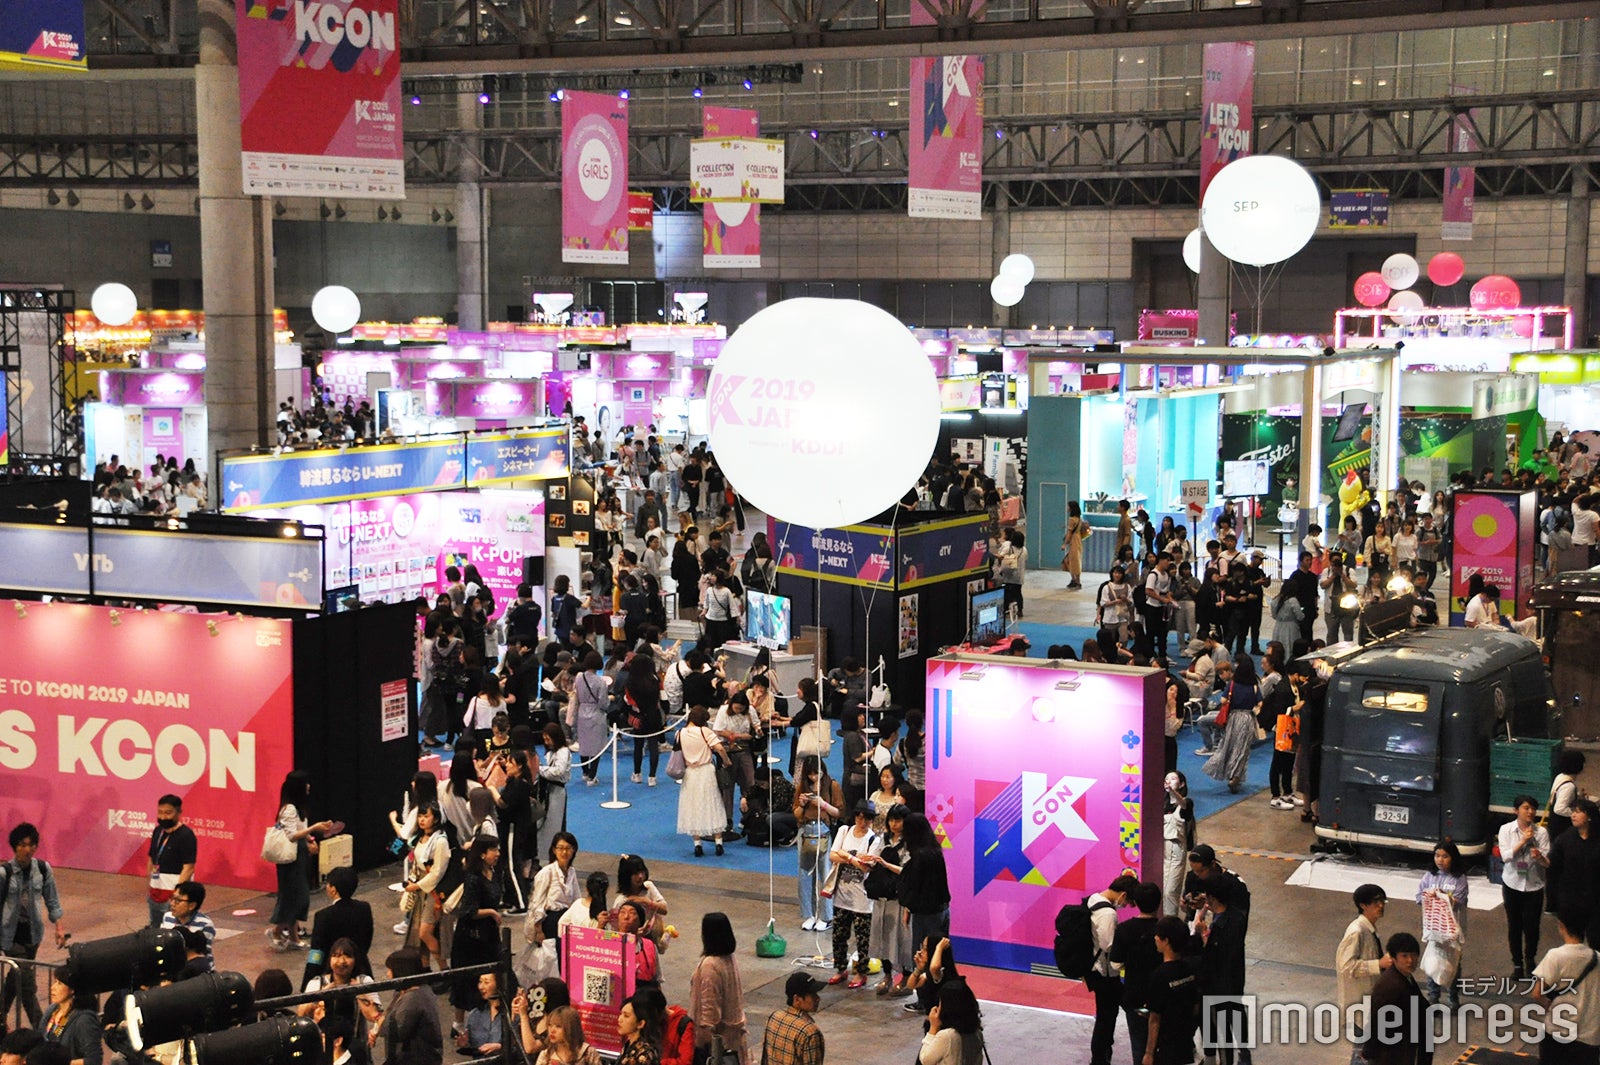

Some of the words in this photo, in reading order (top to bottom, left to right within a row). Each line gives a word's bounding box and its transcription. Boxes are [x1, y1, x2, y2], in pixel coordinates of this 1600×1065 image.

[295, 2, 395, 50] KCON
[1210, 102, 1239, 128] LET'S
[1218, 129, 1250, 152] KCON
[582, 163, 609, 180] GIRLS
[701, 163, 735, 172] COLLECTION
[750, 164, 778, 174] COLLECTION
[750, 377, 817, 400] 2019
[791, 438, 844, 456] KDDI
[300, 466, 362, 487] 韓流見るなら
[362, 463, 403, 481] U-NEXT
[1189, 486, 1207, 496] STAGE
[939, 545, 952, 557] dTV
[820, 556, 848, 568] U-NEXT
[1481, 567, 1503, 575] 2019
[1483, 575, 1512, 584] JAPAN
[10, 679, 32, 695] TO
[36, 681, 84, 700] KCON
[88, 685, 128, 703] 2019
[132, 689, 190, 709] JAPAN
[57, 714, 256, 793] KCON
[1032, 784, 1073, 825] CON
[127, 811, 148, 820] 2019
[206, 819, 225, 829] 2019
[207, 830, 234, 840] MESSE
